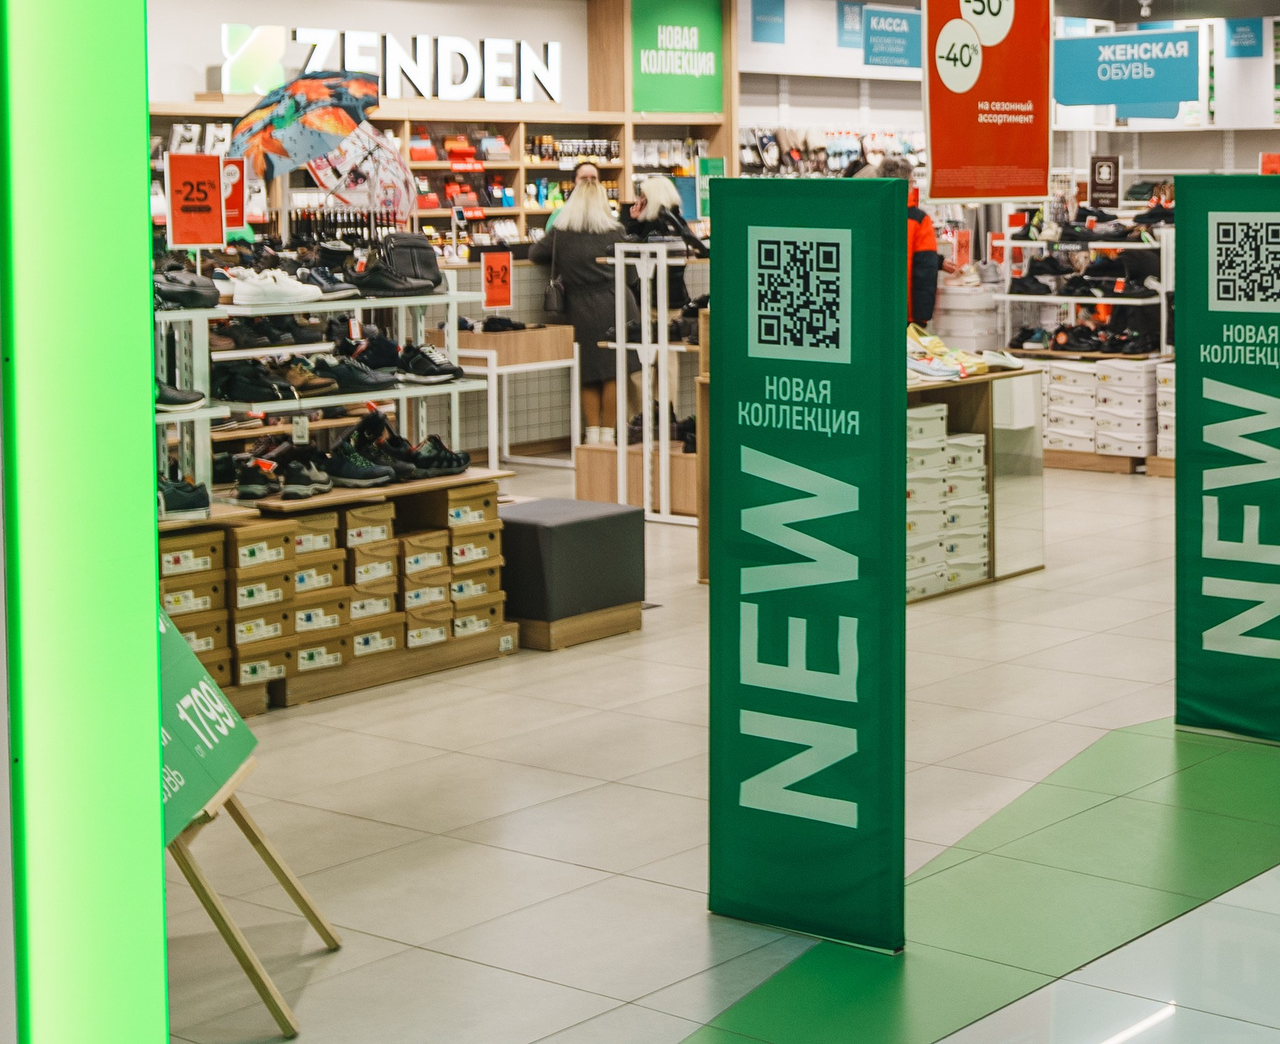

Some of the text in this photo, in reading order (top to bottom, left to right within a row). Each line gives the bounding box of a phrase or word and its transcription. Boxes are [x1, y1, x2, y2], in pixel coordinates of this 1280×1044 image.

[870, 15, 910, 34] КАССА
[657, 24, 699, 51] НОВАЯ
[938, 42, 979, 68] -40%
[1097, 40, 1189, 62] ЖЕНСКАЯ
[640, 49, 715, 78] КОЛЛЕКЦИЯ
[1097, 61, 1155, 81] ОБУВЬ
[978, 99, 1033, 112] на сезонный
[978, 112, 1034, 125] ассортимент
[175, 179, 216, 203] -25%
[486, 264, 508, 285] 3=2
[1222, 324, 1279, 344] НОВАЯ
[764, 375, 831, 405] НОВАЯ
[737, 401, 860, 438] КОЛЛЕКЦИЯ
[739, 444, 859, 829] NEW
[175, 679, 236, 751] 1799
